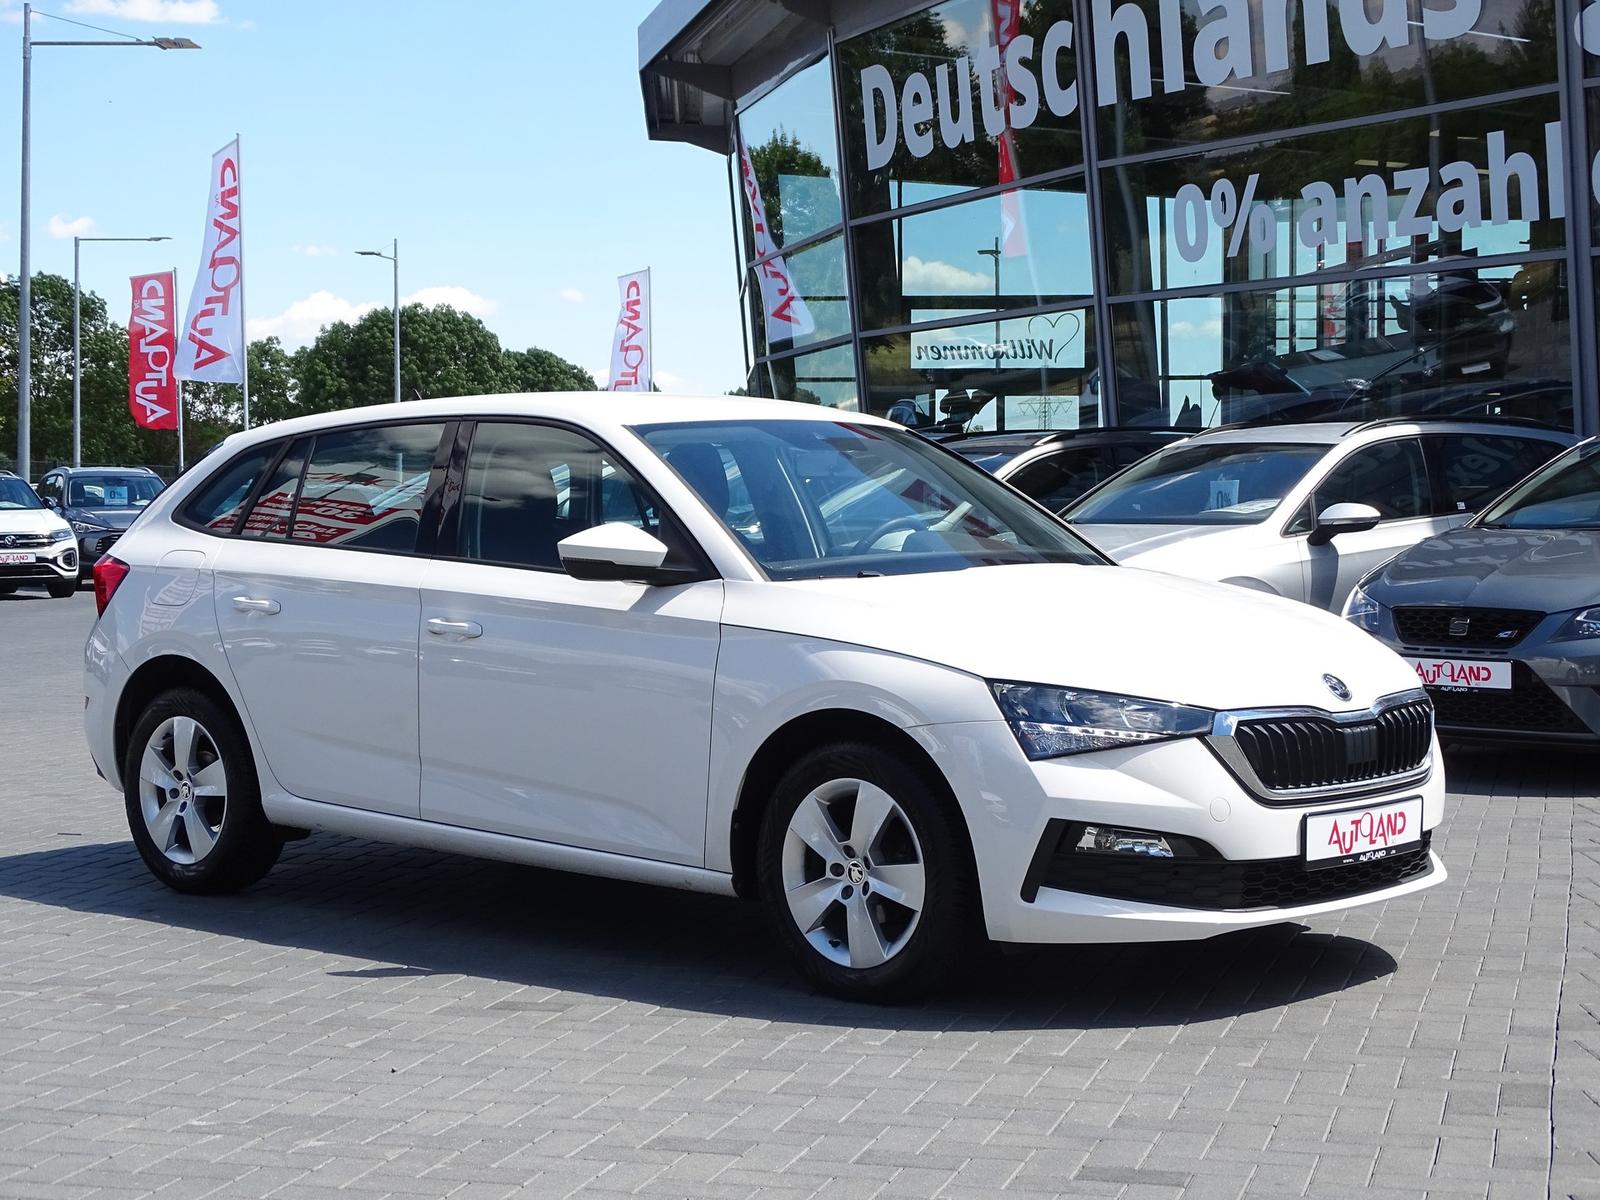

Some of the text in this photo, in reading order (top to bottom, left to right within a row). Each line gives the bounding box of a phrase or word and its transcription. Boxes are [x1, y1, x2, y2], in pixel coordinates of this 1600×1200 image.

[860, 0, 1483, 171] Deutschlan
[1173, 173, 1276, 263] 0%
[1299, 121, 1566, 249] anzahl
[1415, 661, 1491, 686] AUTOLAND
[1328, 811, 1406, 854] AUTOLAND
